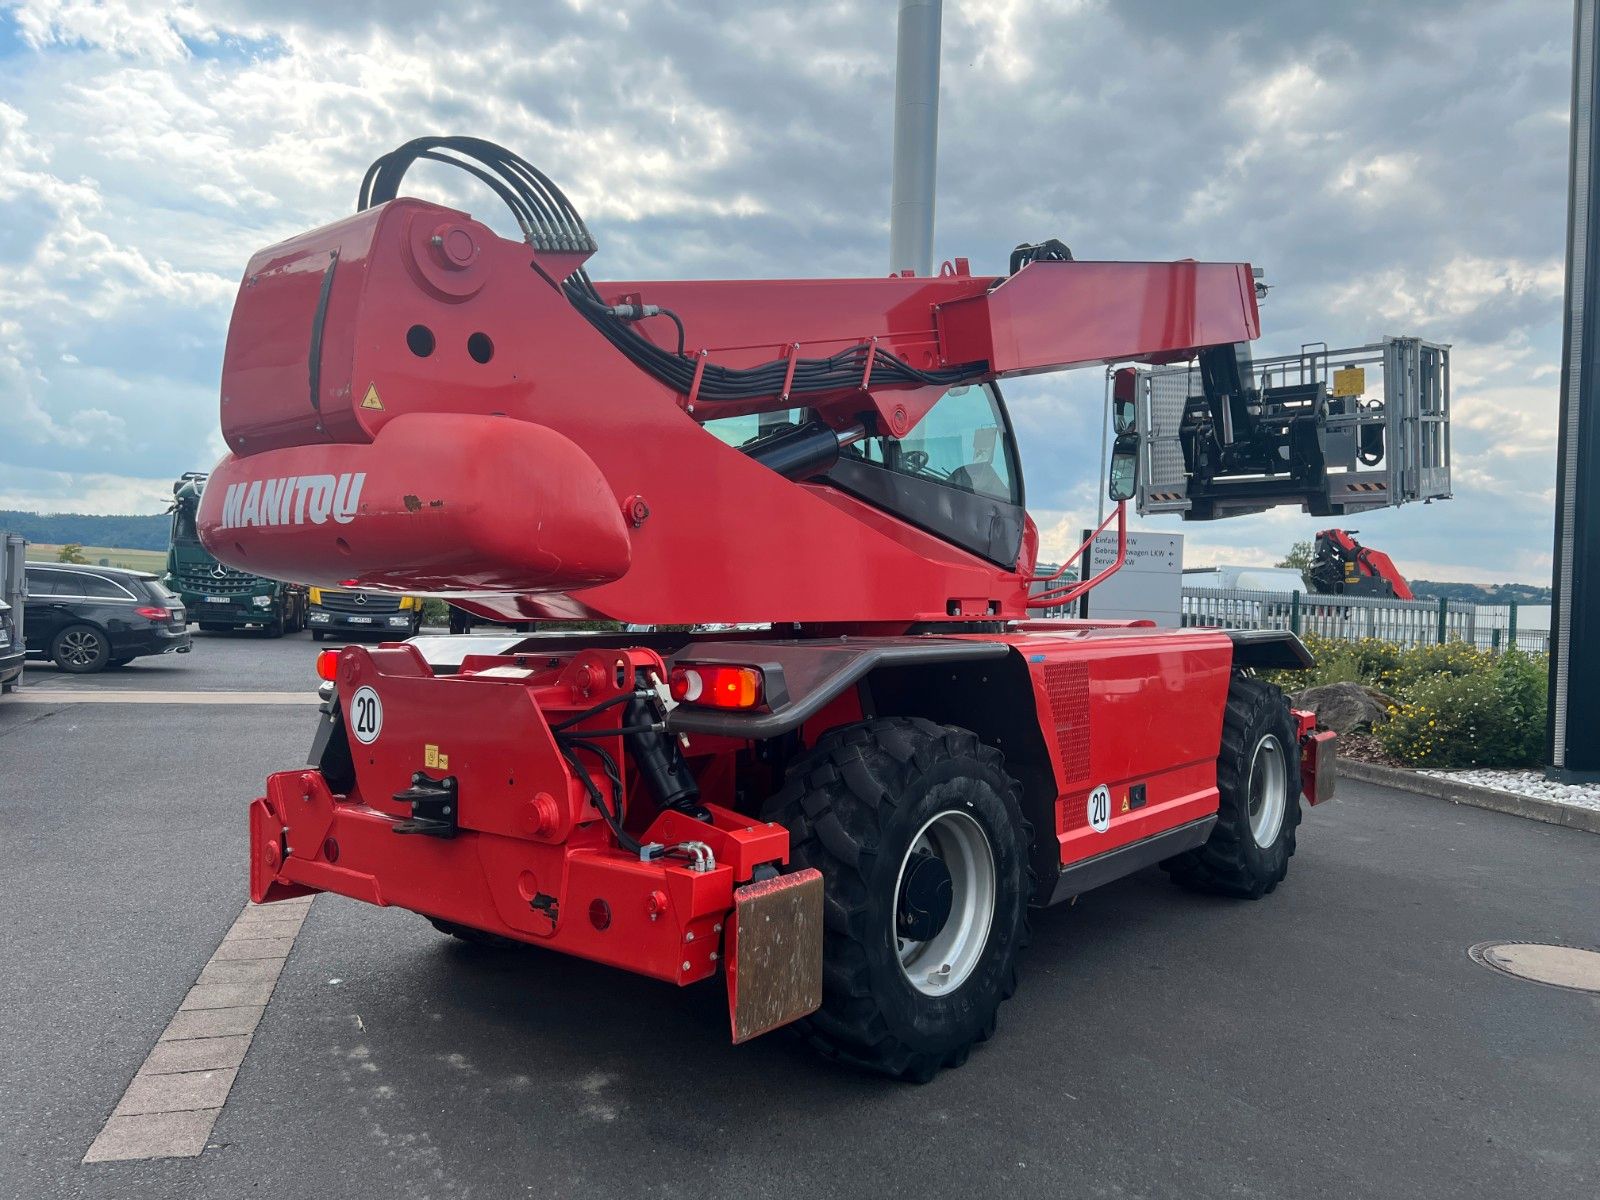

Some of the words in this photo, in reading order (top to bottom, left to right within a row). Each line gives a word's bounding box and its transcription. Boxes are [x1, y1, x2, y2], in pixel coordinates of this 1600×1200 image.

[222, 473, 366, 528] MANITOU
[357, 696, 376, 733] 20
[1093, 792, 1106, 824] 20
